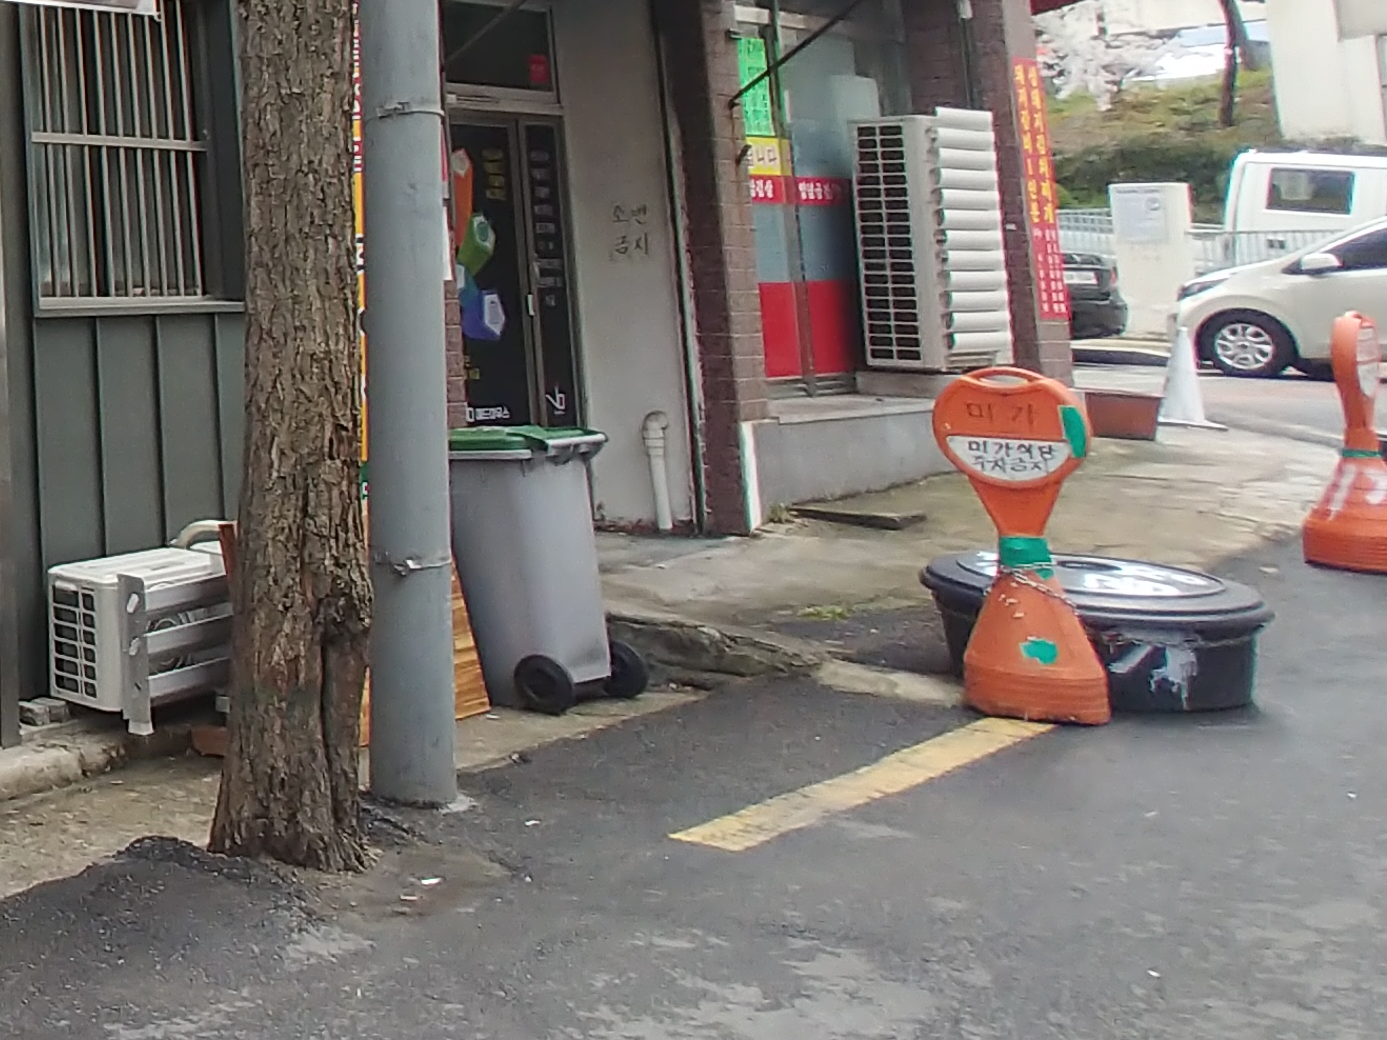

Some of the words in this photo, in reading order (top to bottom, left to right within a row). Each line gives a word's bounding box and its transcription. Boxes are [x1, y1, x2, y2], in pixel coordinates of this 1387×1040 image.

[614, 231, 649, 256] 금지
[965, 401, 1035, 433] 미가
[967, 440, 1054, 459] 미가식당
